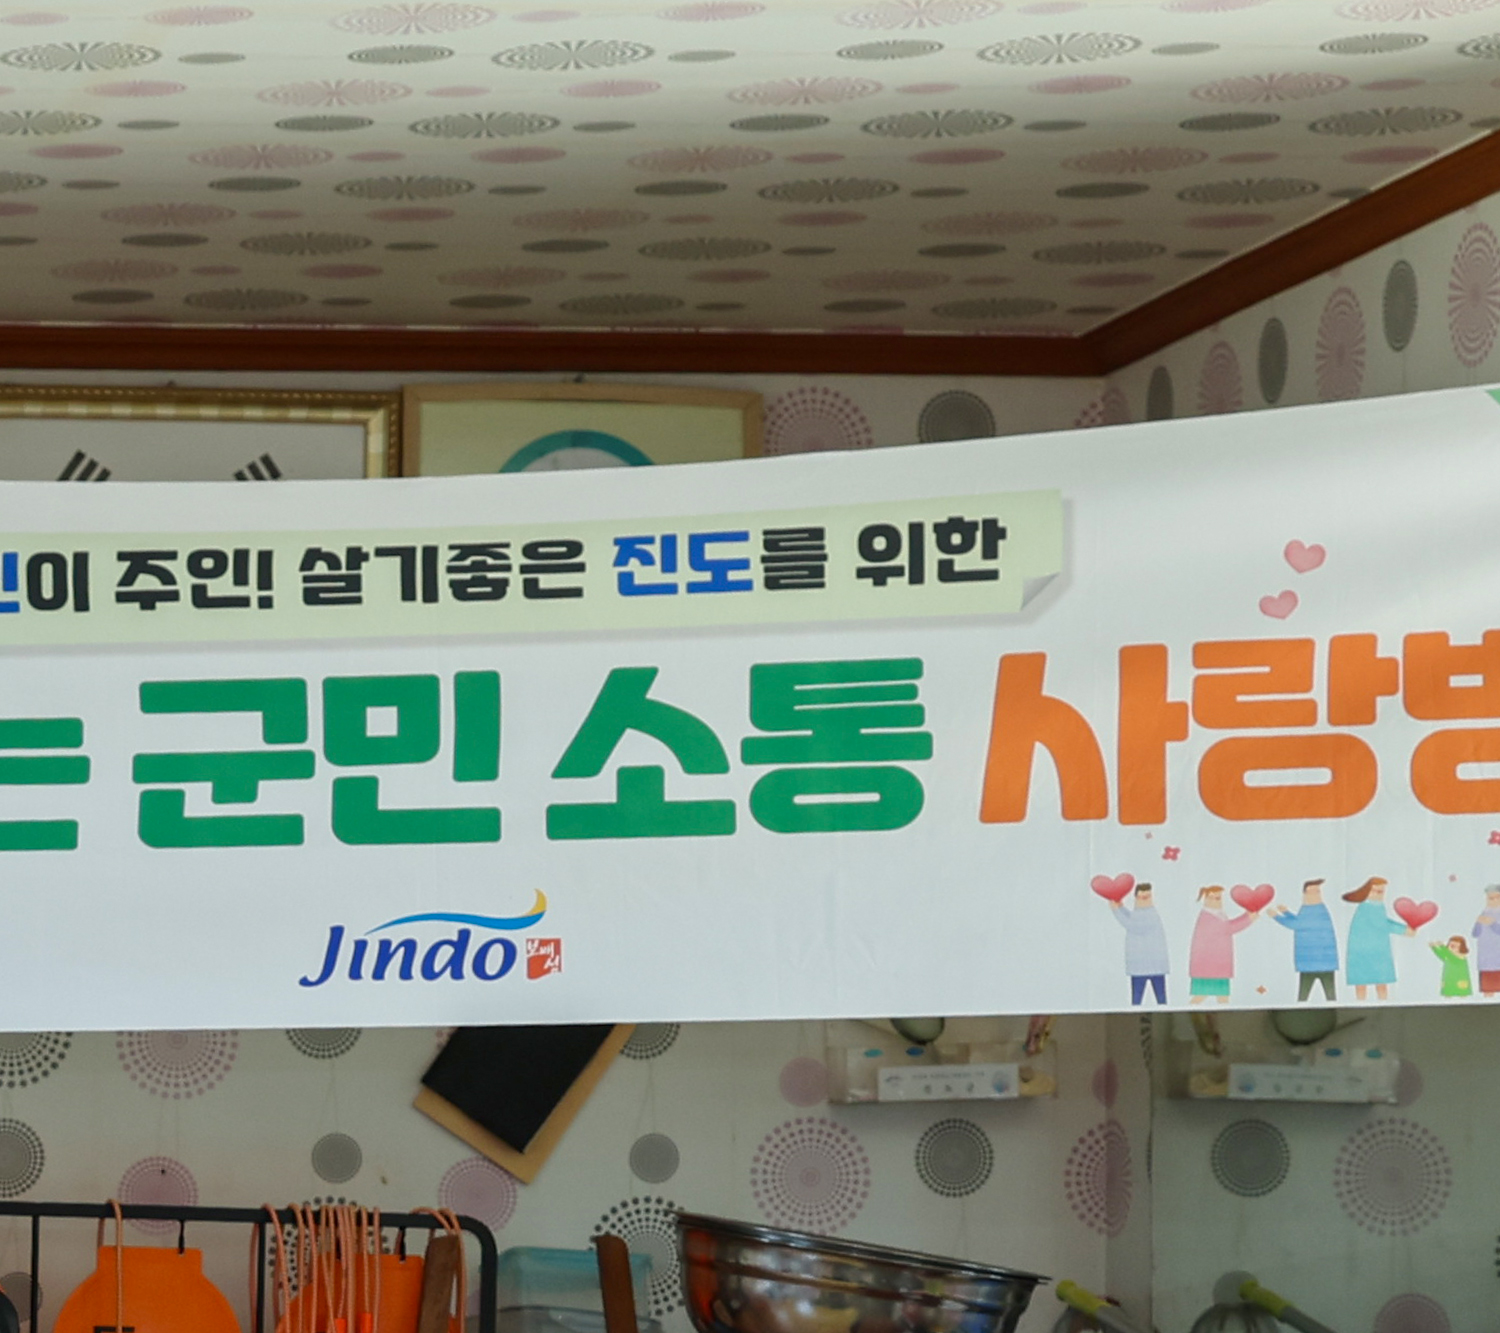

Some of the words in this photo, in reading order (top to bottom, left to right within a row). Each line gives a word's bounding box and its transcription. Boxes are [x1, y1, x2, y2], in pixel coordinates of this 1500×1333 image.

[115, 546, 276, 612] 주인!
[298, 538, 586, 606] 살기좋은
[611, 526, 828, 598] 진도를
[856, 515, 1007, 587] 위한
[131, 670, 502, 849] 군민
[545, 657, 934, 841] 소통
[298, 925, 518, 988] Jindo
